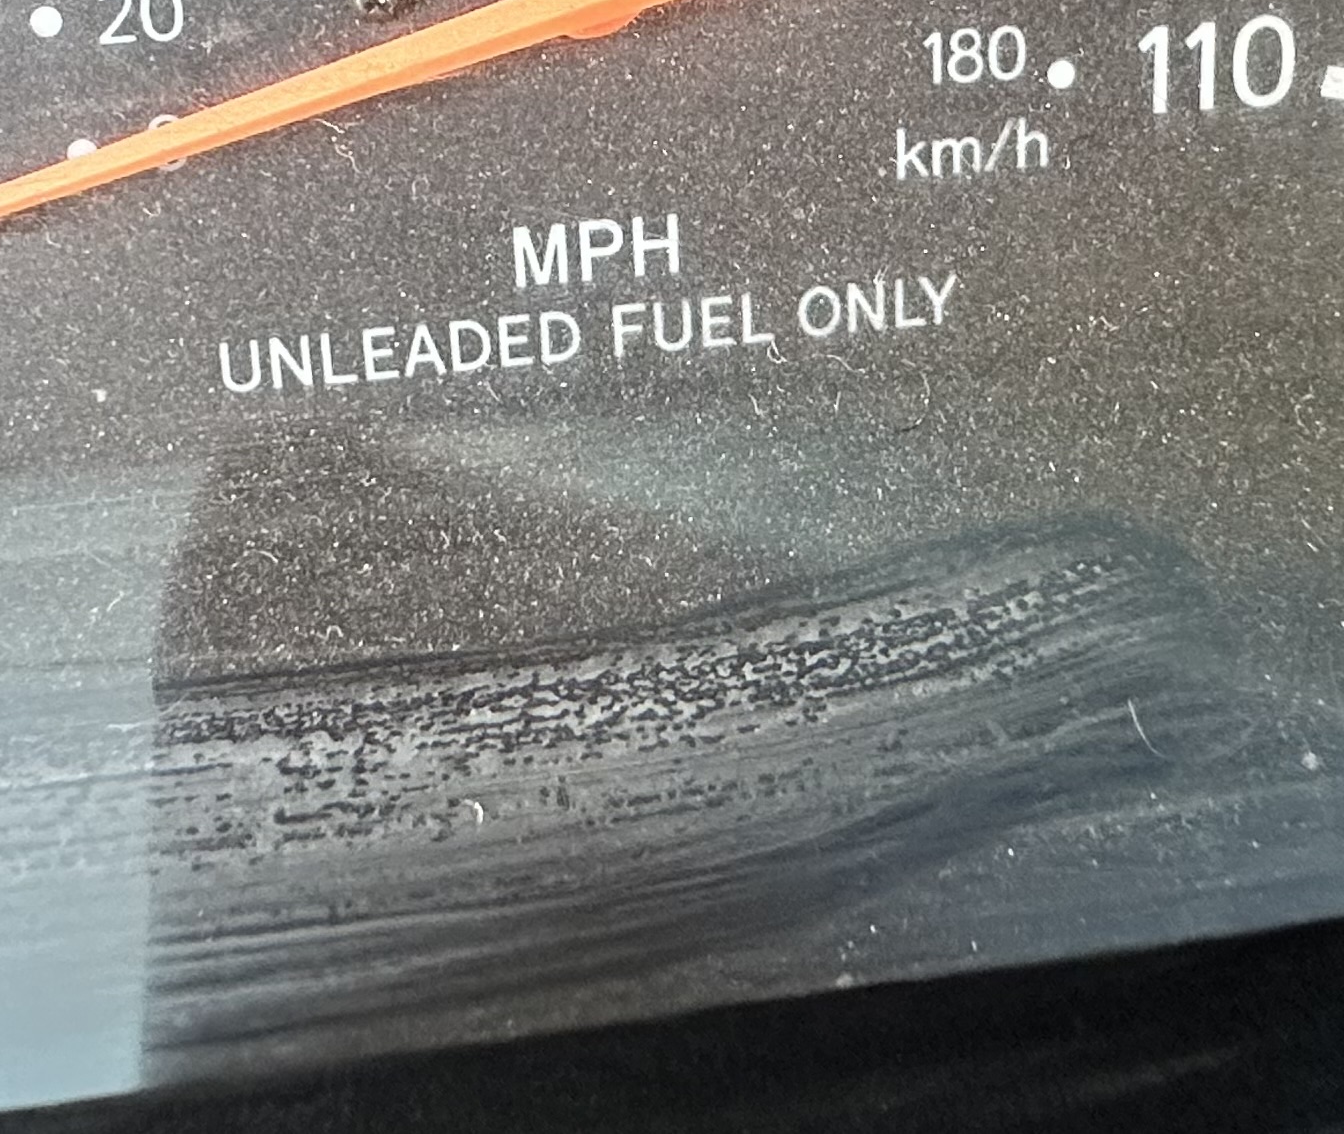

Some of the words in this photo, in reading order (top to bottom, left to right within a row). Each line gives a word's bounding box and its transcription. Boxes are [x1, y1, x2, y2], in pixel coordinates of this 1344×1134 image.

[922, 25, 1026, 84] 180
[1138, 14, 1296, 114] 110
[894, 118, 1051, 180] km/h
[512, 212, 681, 289] MPH
[219, 309, 580, 394] UNLEADED
[612, 294, 774, 360] FUEL
[798, 274, 957, 337] ONLY
